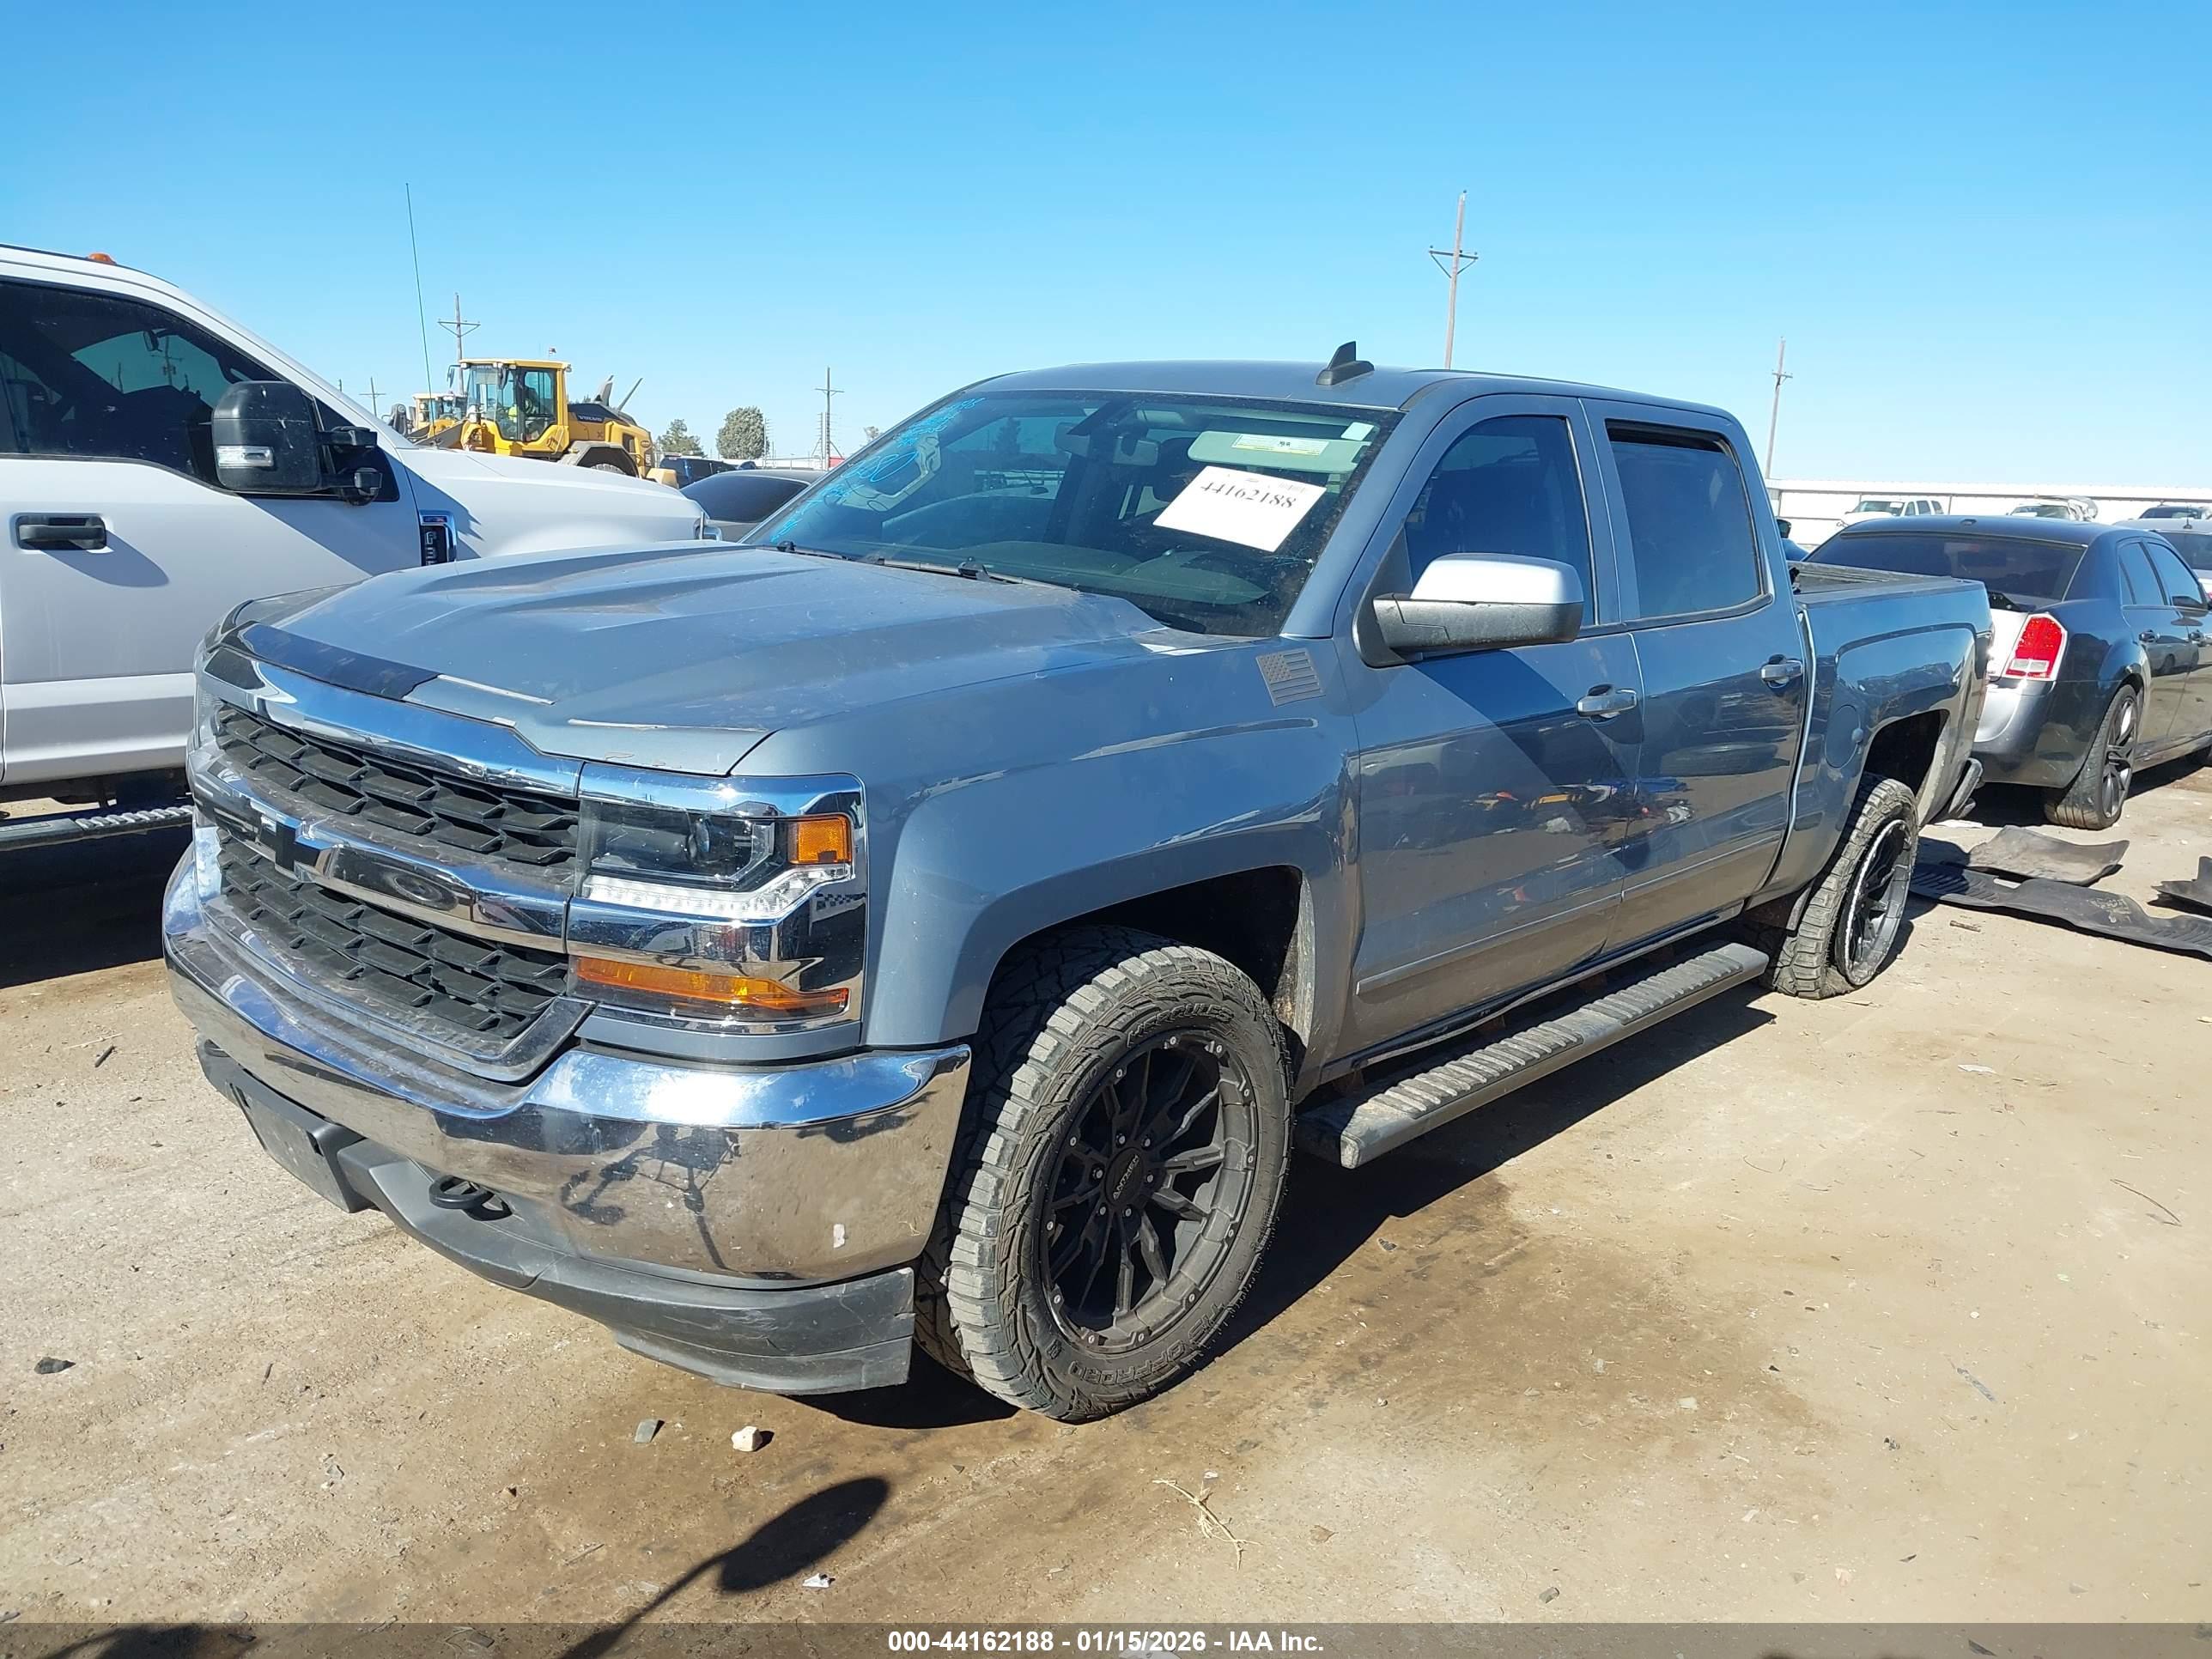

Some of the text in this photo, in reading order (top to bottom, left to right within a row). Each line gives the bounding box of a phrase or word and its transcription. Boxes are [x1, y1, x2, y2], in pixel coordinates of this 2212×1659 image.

[1201, 483, 1297, 509] 44162188
[1126, 1002, 1235, 1048] HERCULES
[1111, 1153, 1139, 1200] ANTHEM
